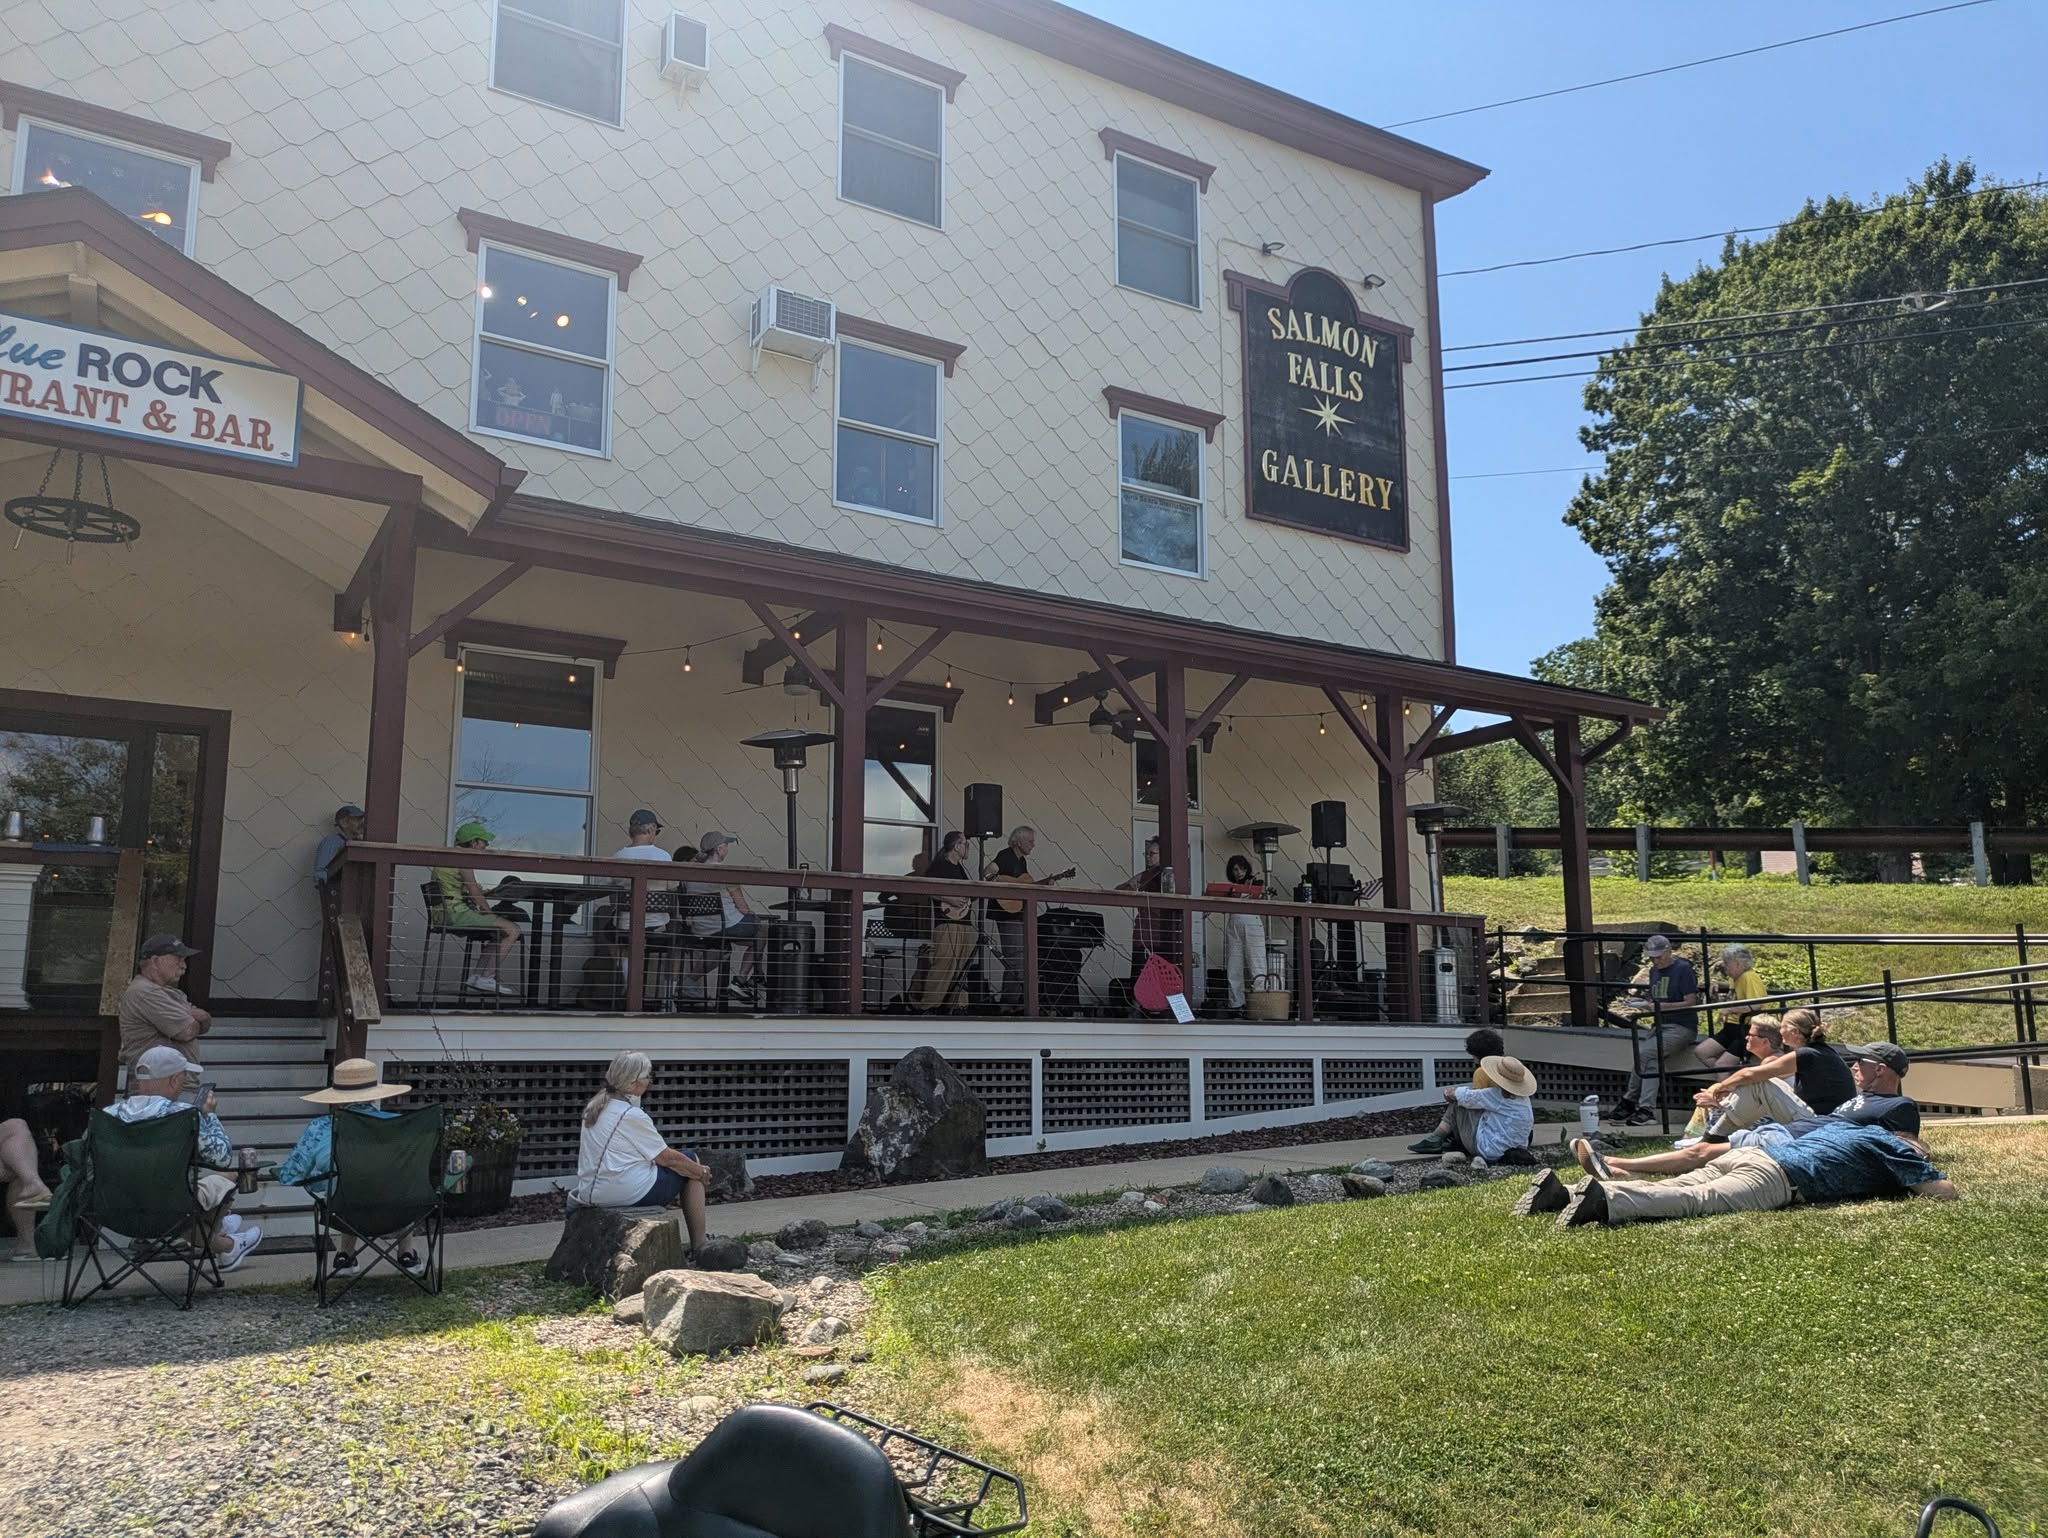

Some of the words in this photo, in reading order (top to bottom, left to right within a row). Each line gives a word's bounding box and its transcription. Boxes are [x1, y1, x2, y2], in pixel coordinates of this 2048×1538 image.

[0, 325, 66, 370] lue
[77, 343, 224, 405] ROCK
[1267, 307, 1379, 369] SALMON
[1288, 352, 1364, 403] FALLS
[0, 369, 129, 425] RANT
[142, 399, 177, 434] &
[190, 407, 275, 452] BAR
[1262, 449, 1394, 511] GALLERY
